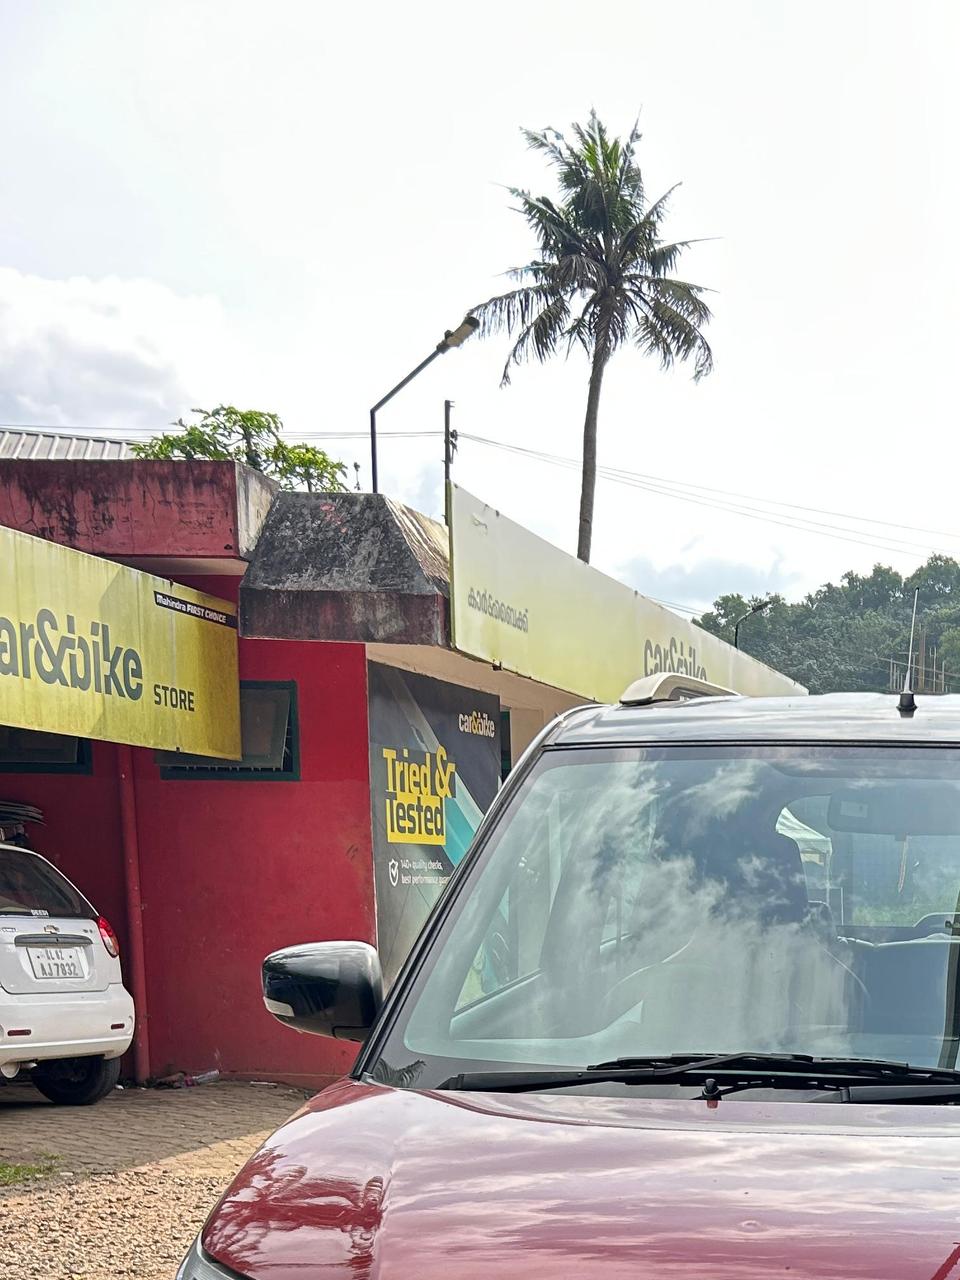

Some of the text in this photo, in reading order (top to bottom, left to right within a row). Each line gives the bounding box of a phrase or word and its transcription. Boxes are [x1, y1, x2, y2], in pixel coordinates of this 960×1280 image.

[156, 594, 226, 623] Mahindra FIRST CHOICE
[0, 608, 143, 700] ar&bike
[153, 684, 195, 711] STORE
[458, 710, 495, 738] car&bike
[383, 744, 456, 798] Tried &
[386, 796, 445, 836] Tested
